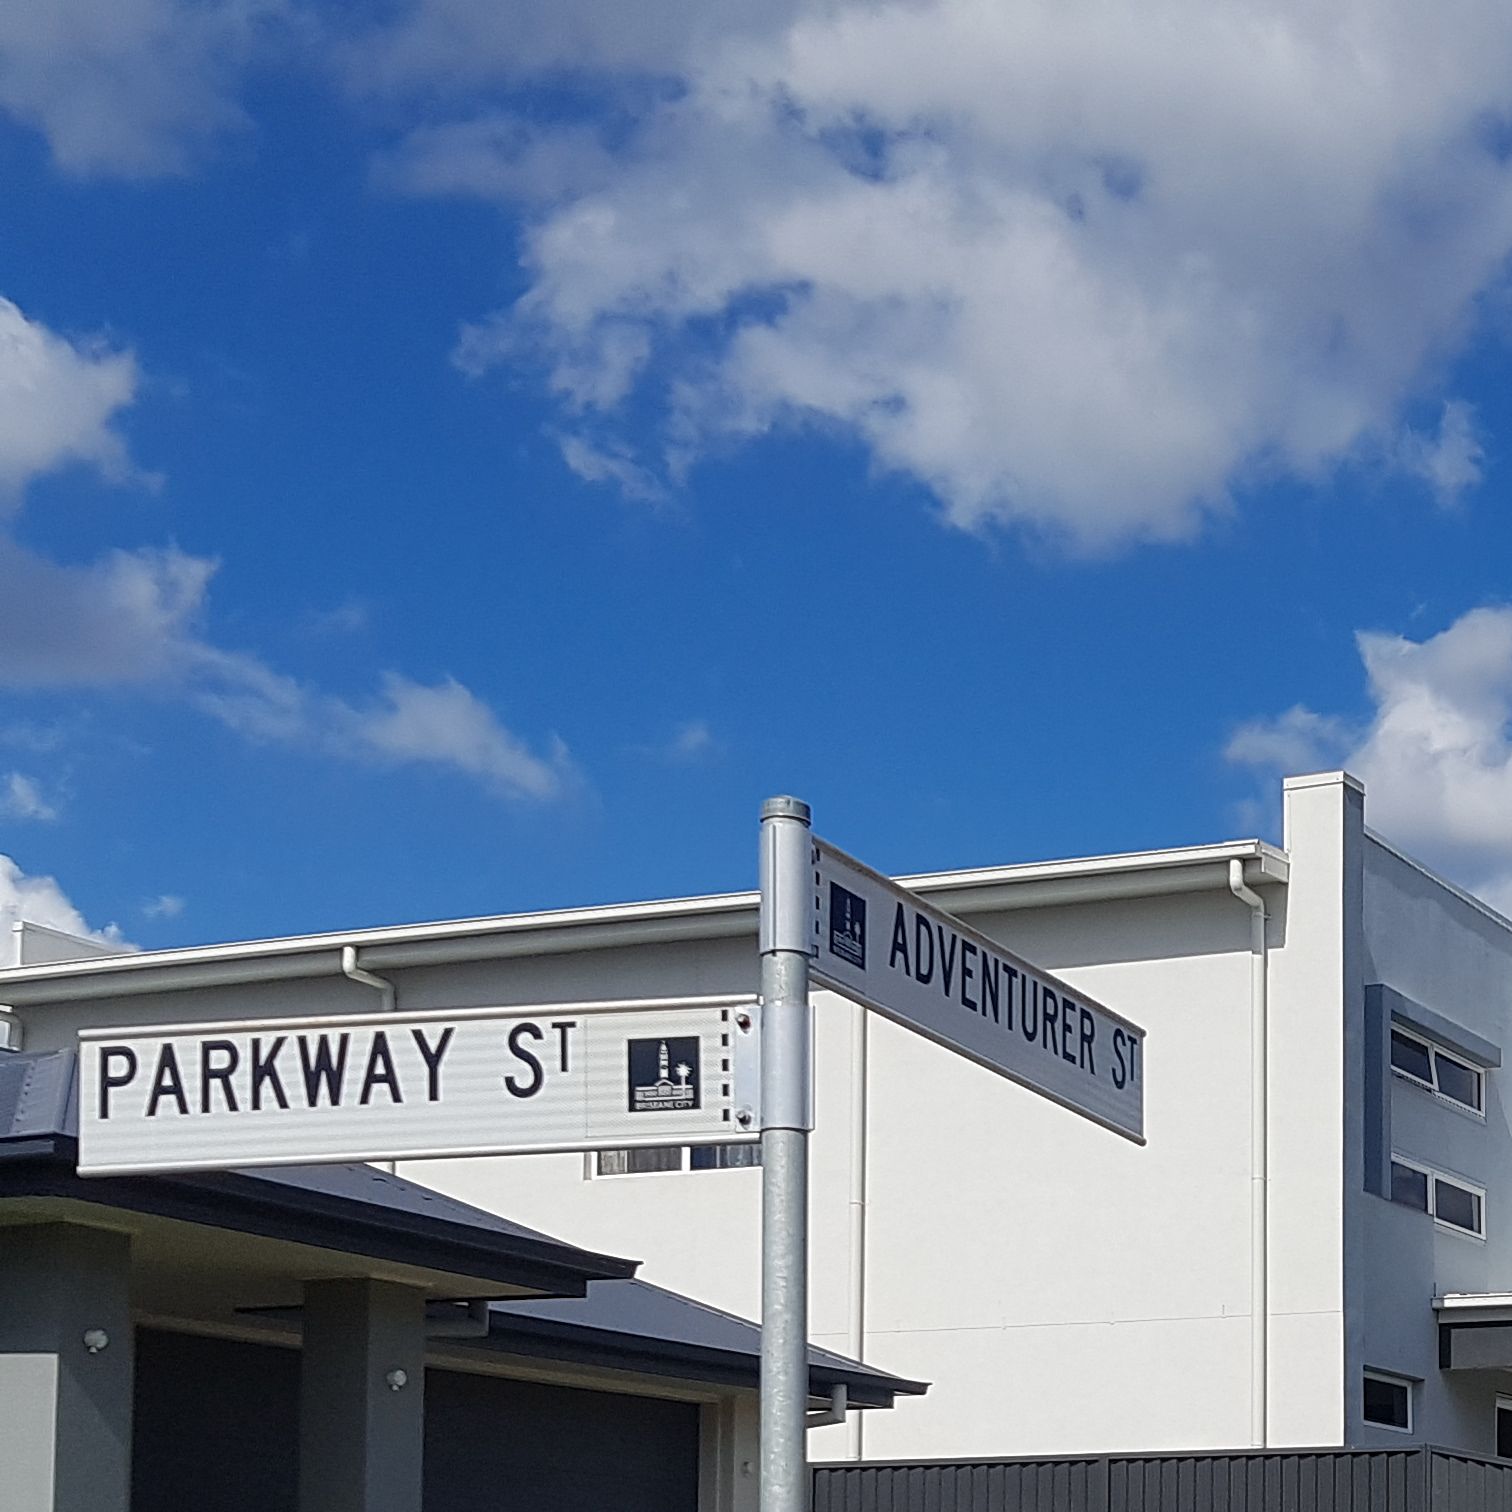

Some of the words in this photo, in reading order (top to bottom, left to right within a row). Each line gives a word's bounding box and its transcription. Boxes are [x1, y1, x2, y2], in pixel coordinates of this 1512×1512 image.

[888, 900, 1097, 1076] ADVENTURER
[1110, 1027, 1138, 1090] ST
[99, 1027, 455, 1120] PARKWAY
[504, 1021, 577, 1099] ST
